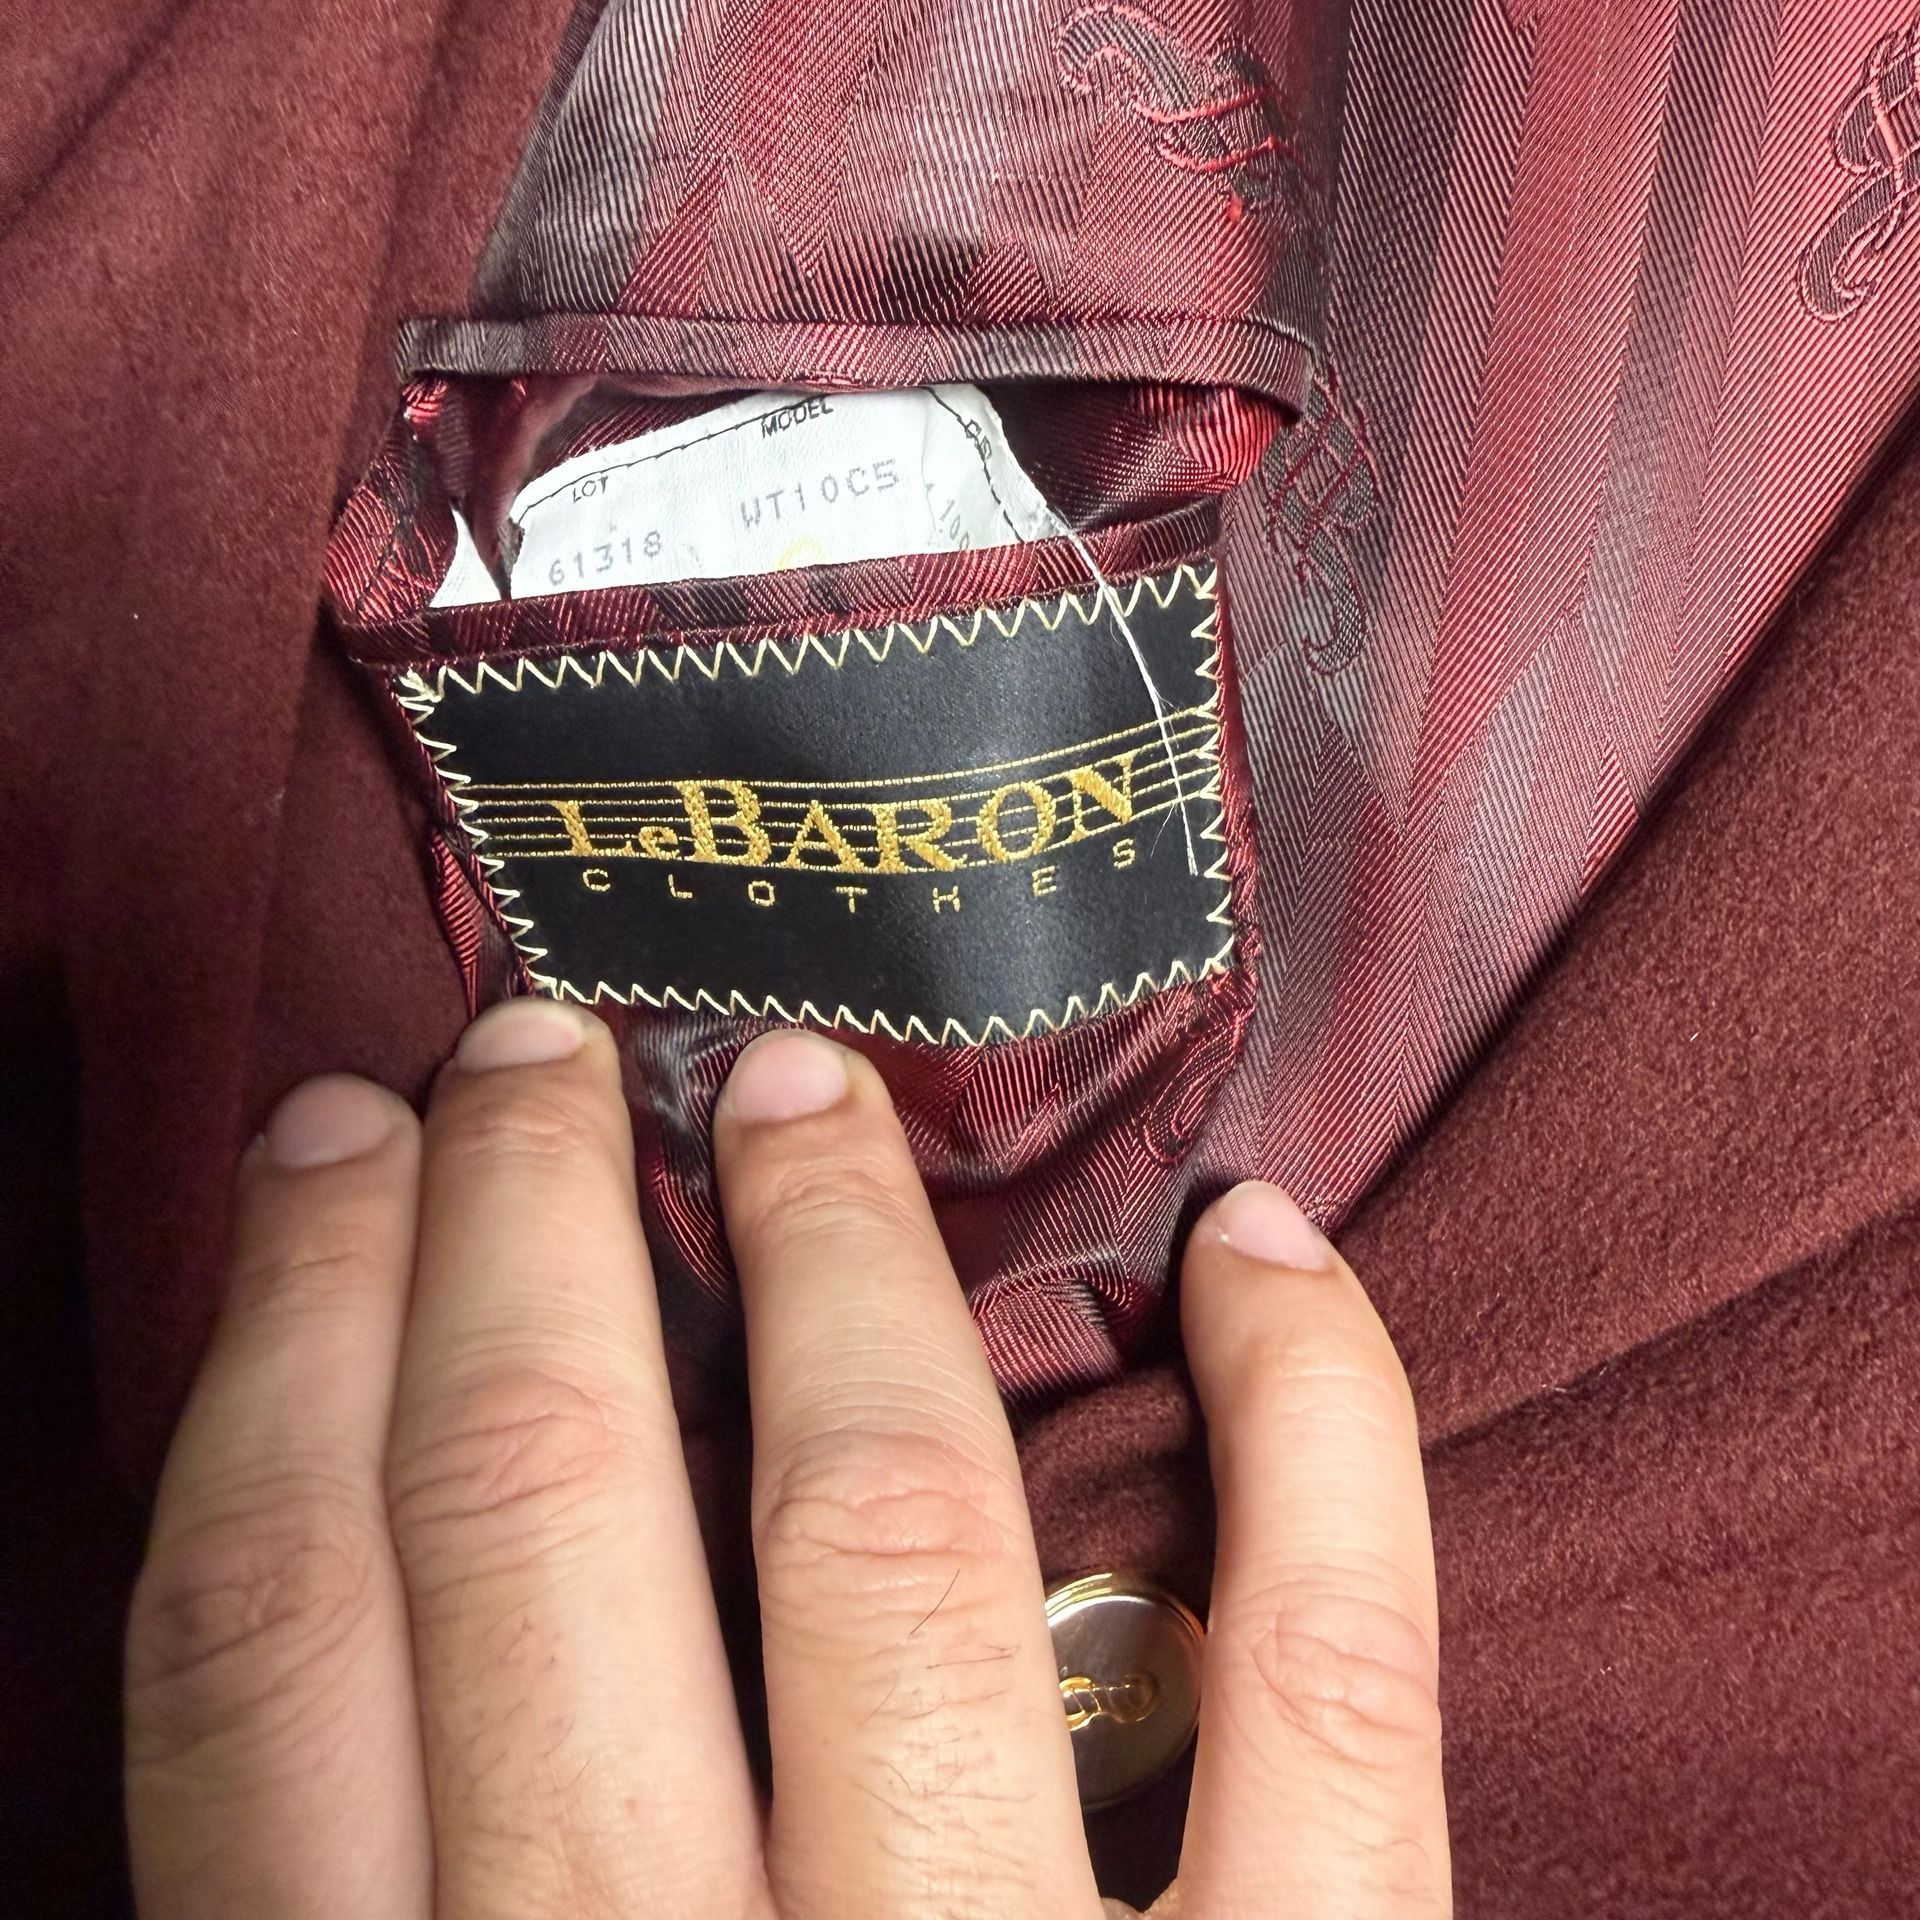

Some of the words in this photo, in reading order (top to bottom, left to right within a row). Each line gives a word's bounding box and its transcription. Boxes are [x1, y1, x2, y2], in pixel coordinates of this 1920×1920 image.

[761, 396, 834, 438] MODEL
[572, 475, 609, 504] LOT
[548, 529, 662, 586] 61318
[550, 752, 1138, 873] LeBARON
